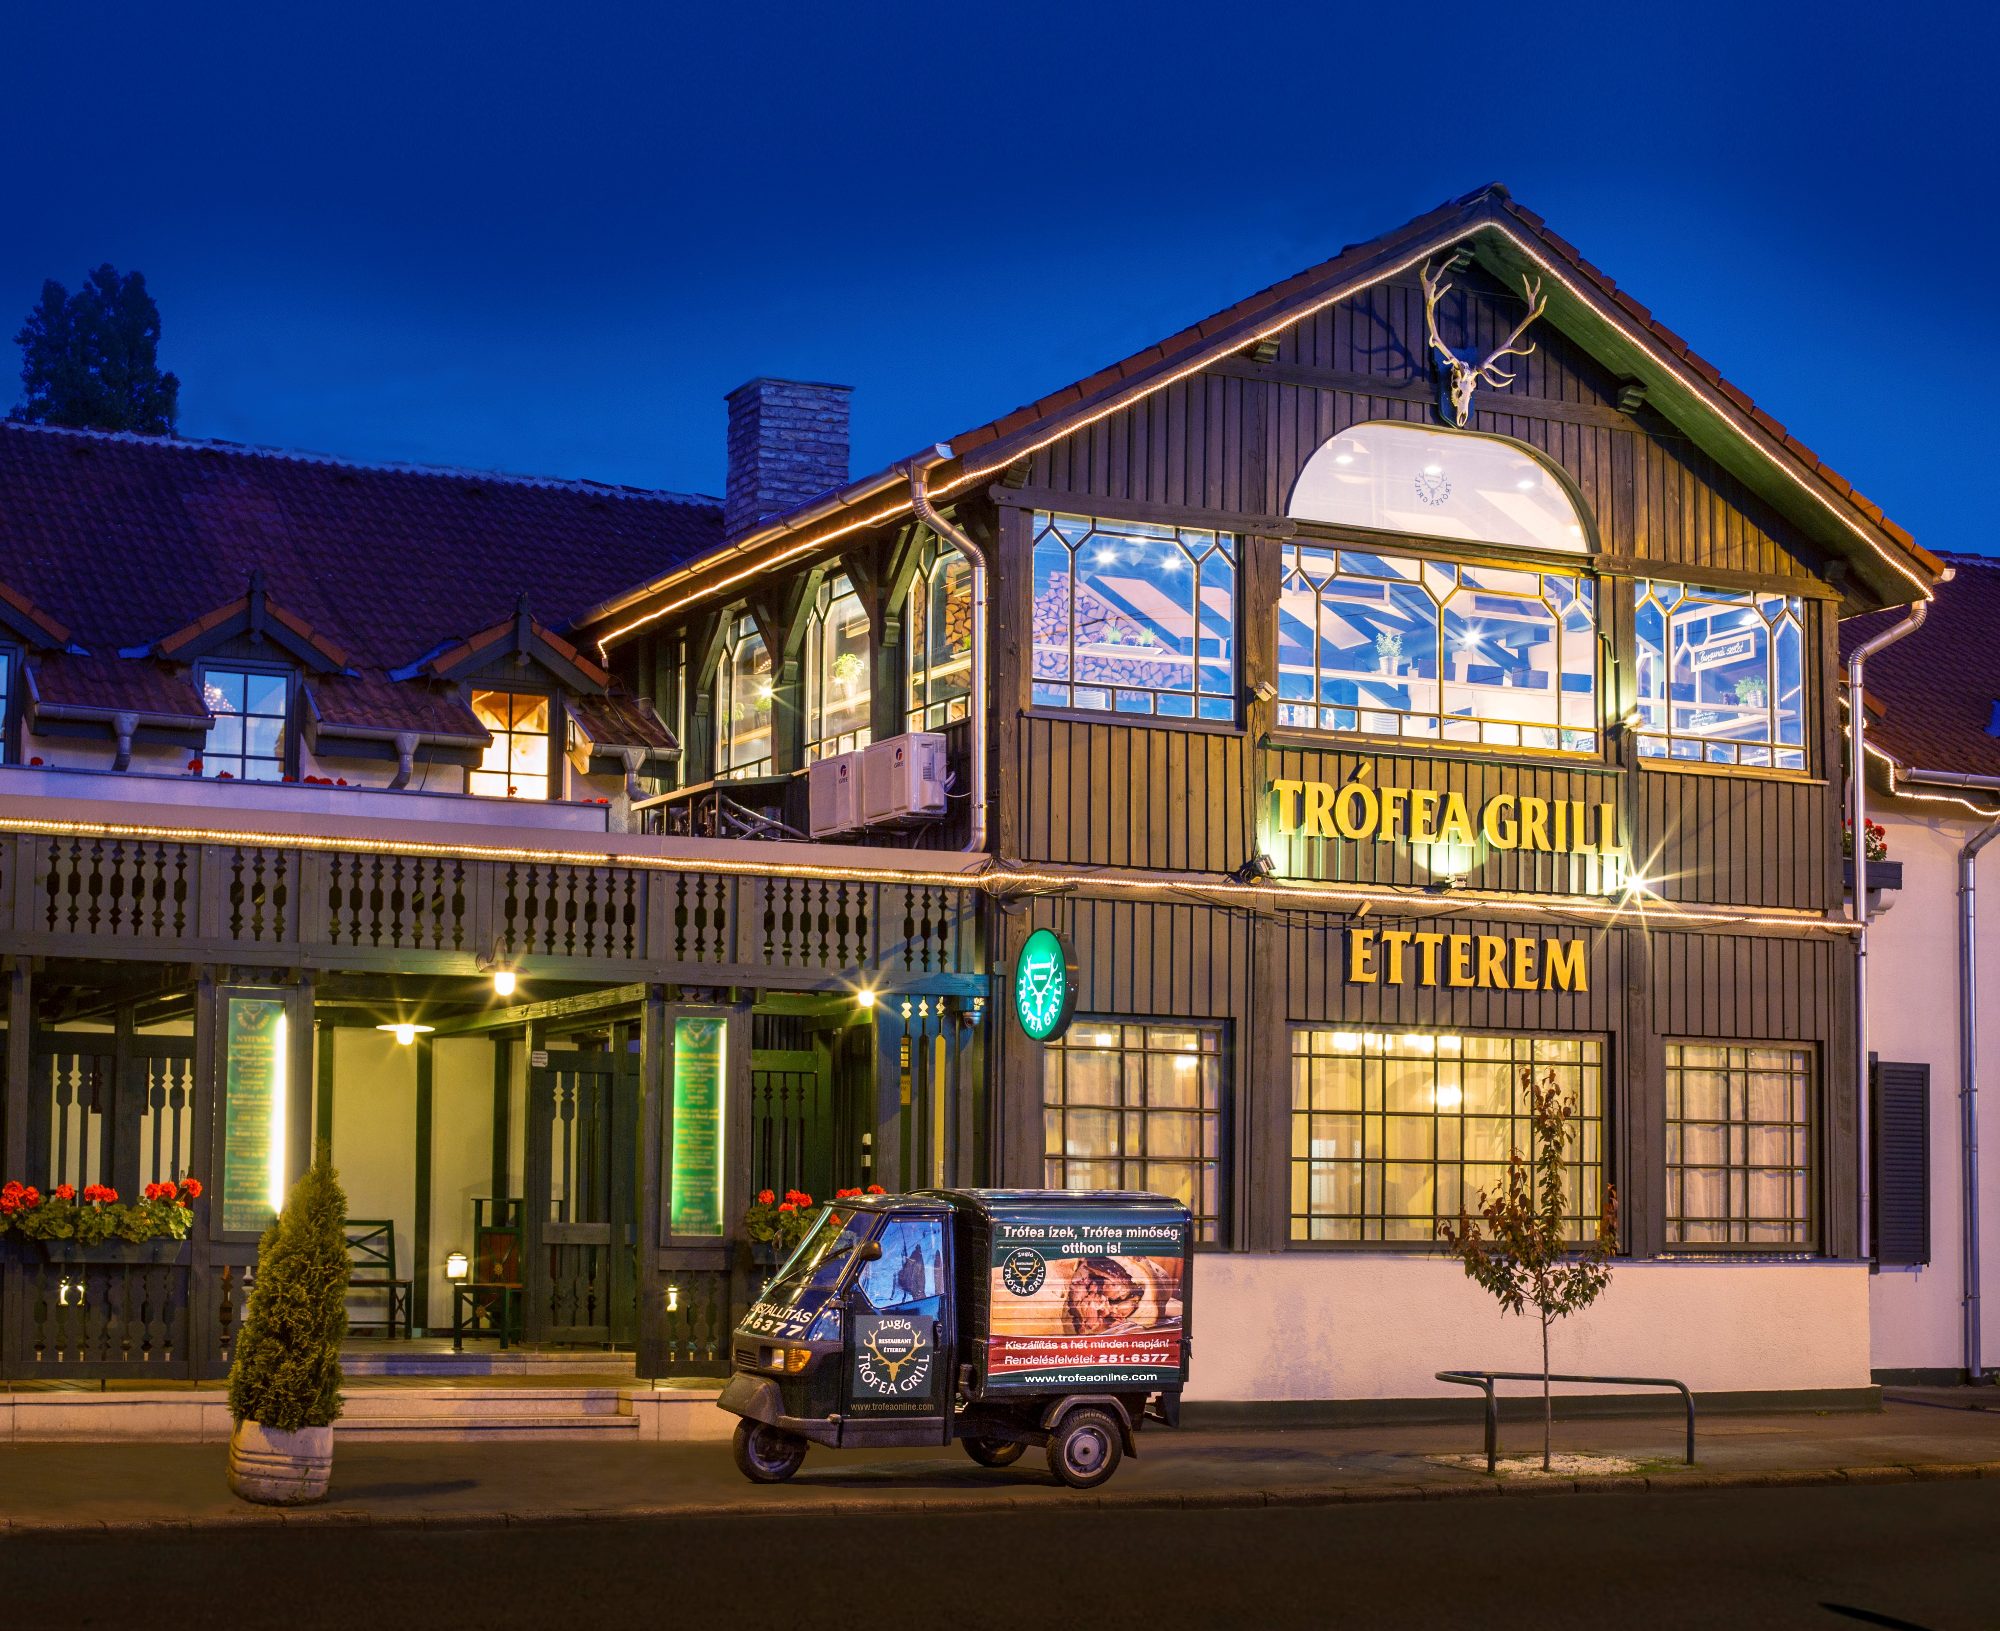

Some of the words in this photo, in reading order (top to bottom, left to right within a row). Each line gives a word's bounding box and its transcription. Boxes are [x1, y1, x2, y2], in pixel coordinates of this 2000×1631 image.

[1271, 761, 1477, 848] TRÓFEA
[1483, 793, 1625, 857] GRILL
[1347, 900, 1589, 992] ÉTTEREM
[1044, 972, 1063, 1026] GRILL
[1003, 1225, 1045, 1238] Trófea
[1049, 1226, 1078, 1240] ízek,
[1082, 1226, 1122, 1238] Trófea
[1062, 1242, 1103, 1254] otthon
[1107, 1242, 1121, 1254] is!
[1005, 1268, 1027, 1294] TRÓFEA
[1028, 1267, 1045, 1292] GRILL
[878, 1318, 912, 1331] Zugló
[1005, 1340, 1058, 1350] Kiszállítás
[1060, 1342, 1068, 1350] a
[1070, 1340, 1088, 1349] hét
[1090, 1339, 1129, 1349] minden
[1004, 1354, 1096, 1365] Rendelésfelvétel:
[1098, 1353, 1169, 1363] 251-6377
[858, 1353, 898, 1395] TRÓFEA
[900, 1354, 930, 1391] GRILL
[1024, 1372, 1158, 1383] www.trofeaonline.com
[850, 1402, 934, 1411] www.trofeaonline.com
